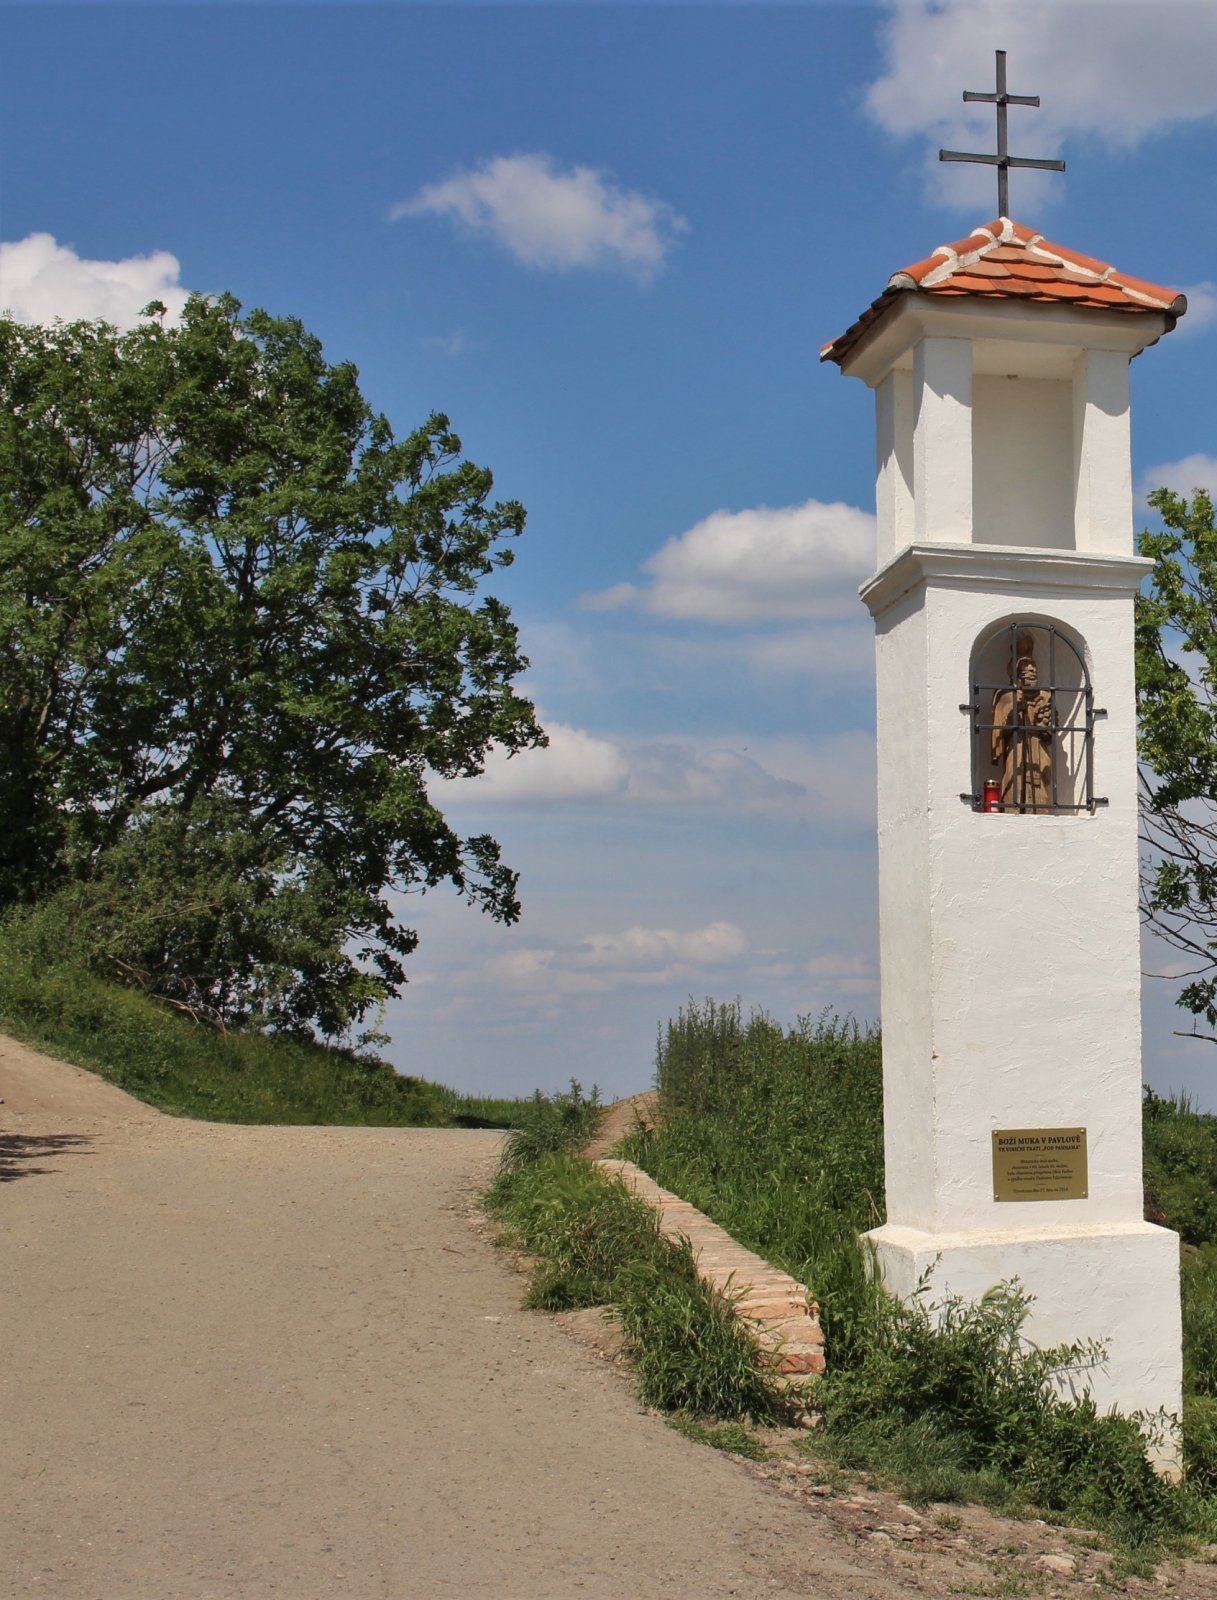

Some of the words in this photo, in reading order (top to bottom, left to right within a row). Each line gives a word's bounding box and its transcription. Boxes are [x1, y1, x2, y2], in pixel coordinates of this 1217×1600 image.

[999, 1136, 1016, 1145] BOŽÍ
[1018, 1137, 1040, 1145] MUKA
[1048, 1135, 1080, 1144] PAVLOVĚ
